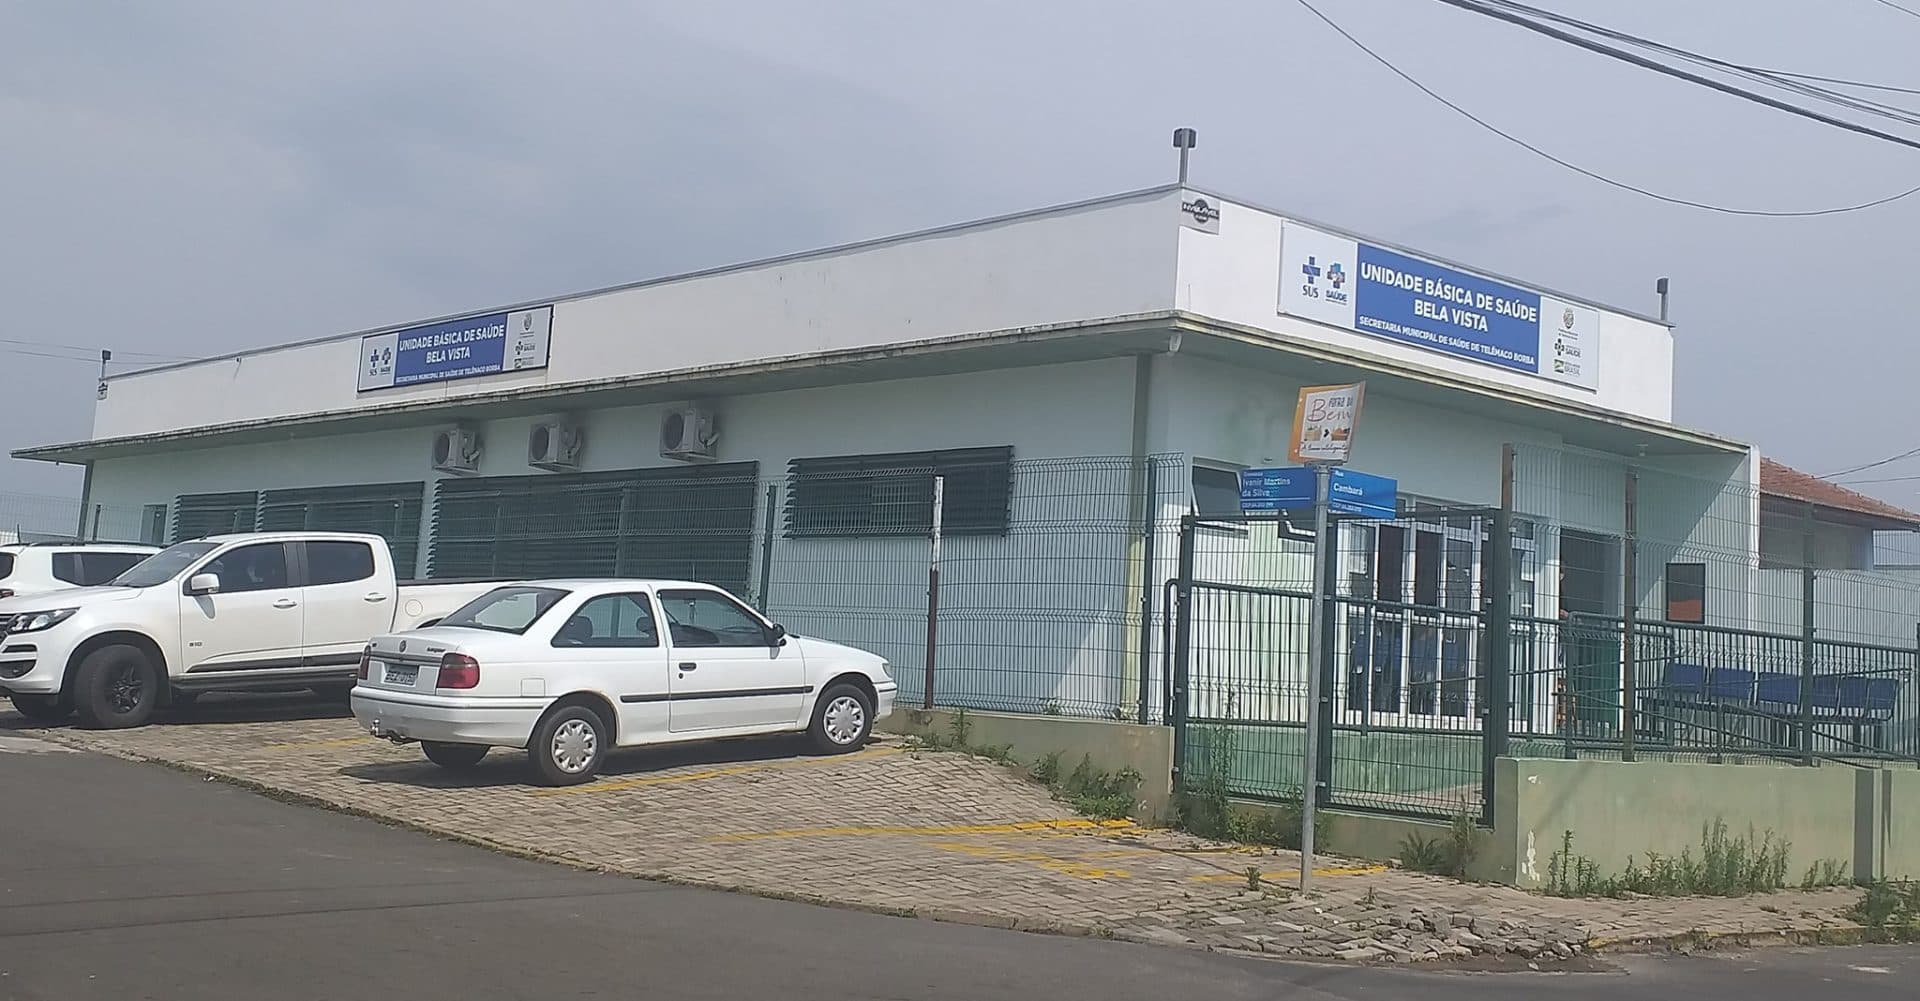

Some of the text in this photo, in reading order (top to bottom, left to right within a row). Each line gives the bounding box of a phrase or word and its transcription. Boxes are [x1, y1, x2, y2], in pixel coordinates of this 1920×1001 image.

[1302, 284, 1319, 299] SUS
[1361, 262, 1537, 323] UNIDADE BÁSICA DE SAÚDE
[1414, 299, 1488, 332] BELA VISTA
[399, 336, 433, 351] UNIDADE
[433, 331, 463, 347] BÁSICA
[464, 329, 476, 342] DE
[475, 323, 505, 340] SAÚDE
[1359, 315, 1535, 365] SECRETARIA MUNICIPAL DE SAÚDE DE TELÊMACO BORBA
[426, 346, 471, 364] BELA VISTA
[1241, 488, 1270, 497] da Silva
[1333, 482, 1363, 496] Cambará
